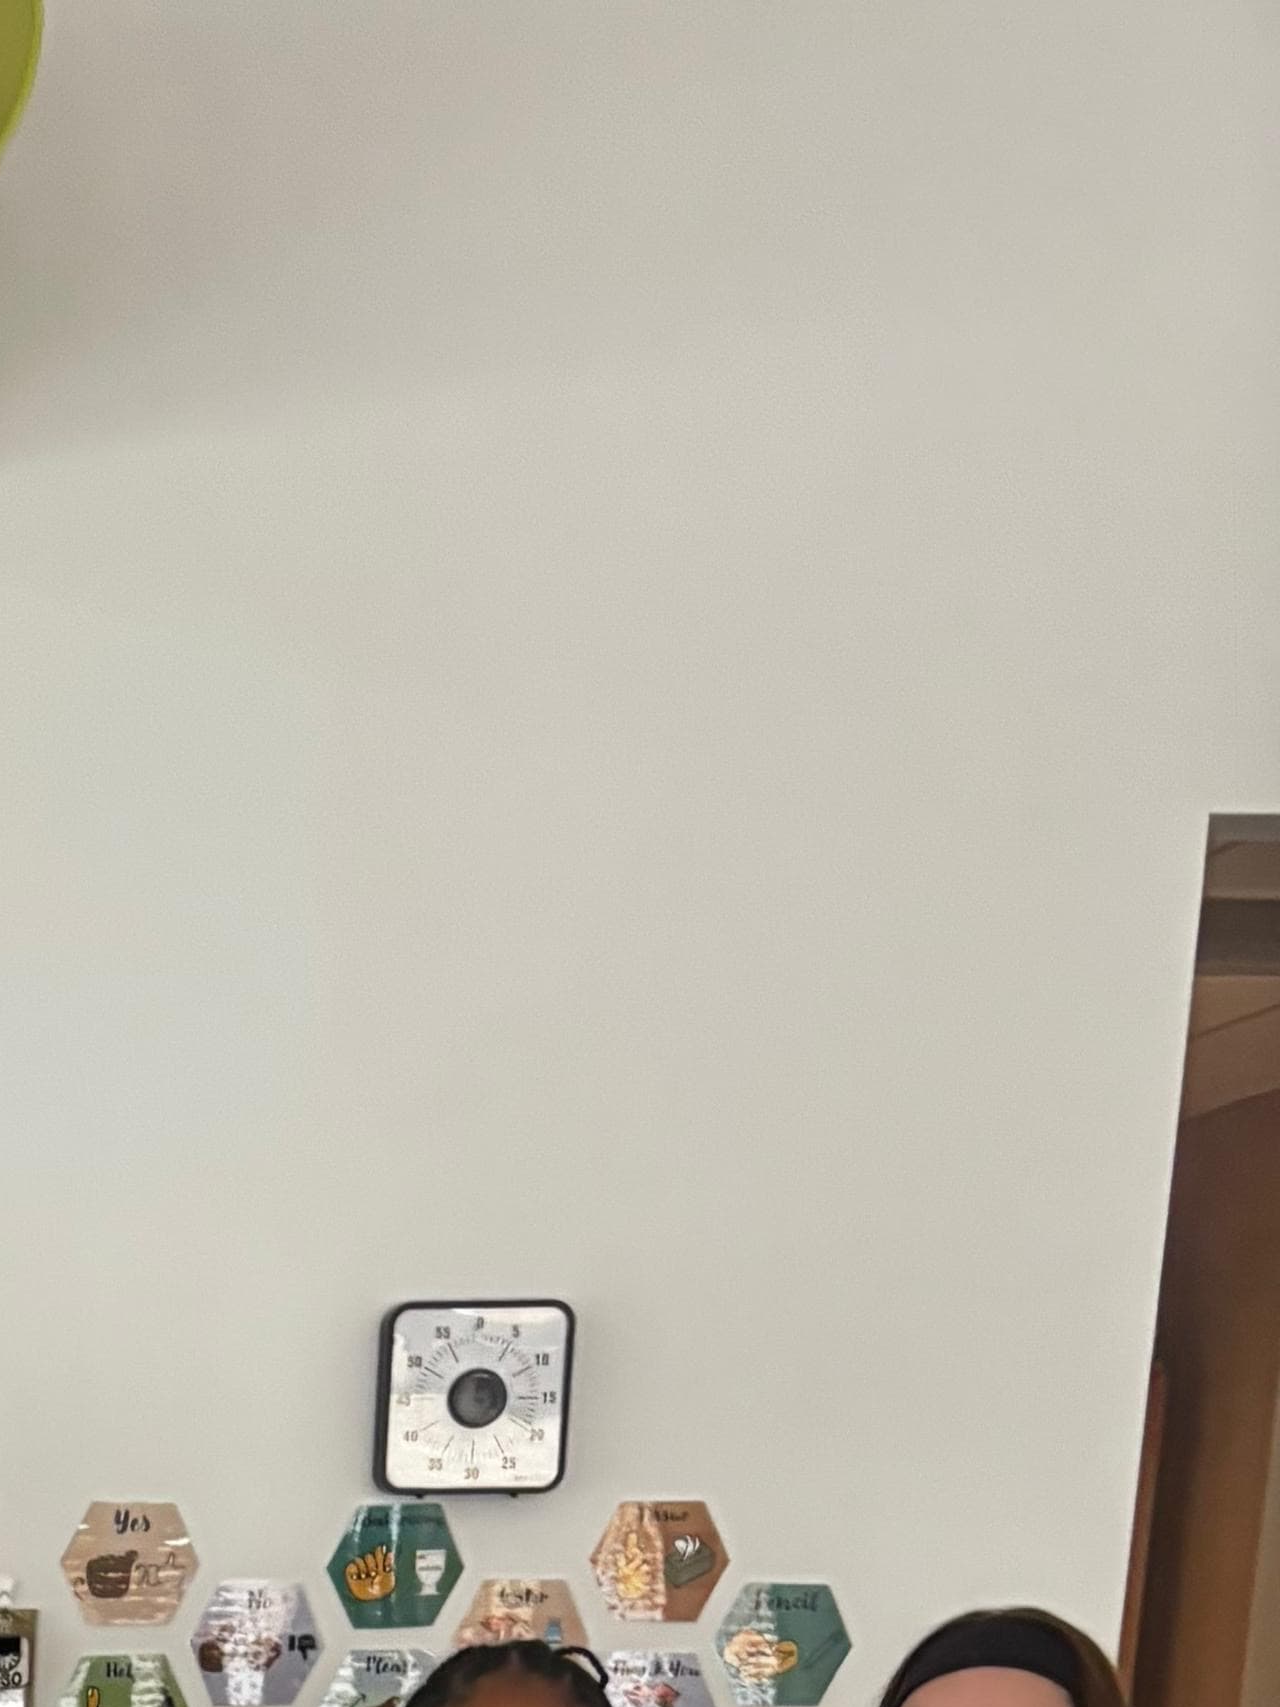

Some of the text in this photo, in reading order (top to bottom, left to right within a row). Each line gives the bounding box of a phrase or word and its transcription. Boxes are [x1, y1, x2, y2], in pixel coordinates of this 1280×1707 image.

[436, 1326, 450, 1339] 55
[512, 1325, 520, 1338] 5
[407, 1356, 422, 1368] 50
[536, 1354, 550, 1366] 10
[542, 1391, 556, 1403] 15
[403, 1430, 418, 1442] 40
[428, 1458, 443, 1471] 35
[502, 1457, 516, 1469] 25
[464, 1467, 479, 1480] 30
[114, 1508, 151, 1534] Yes
